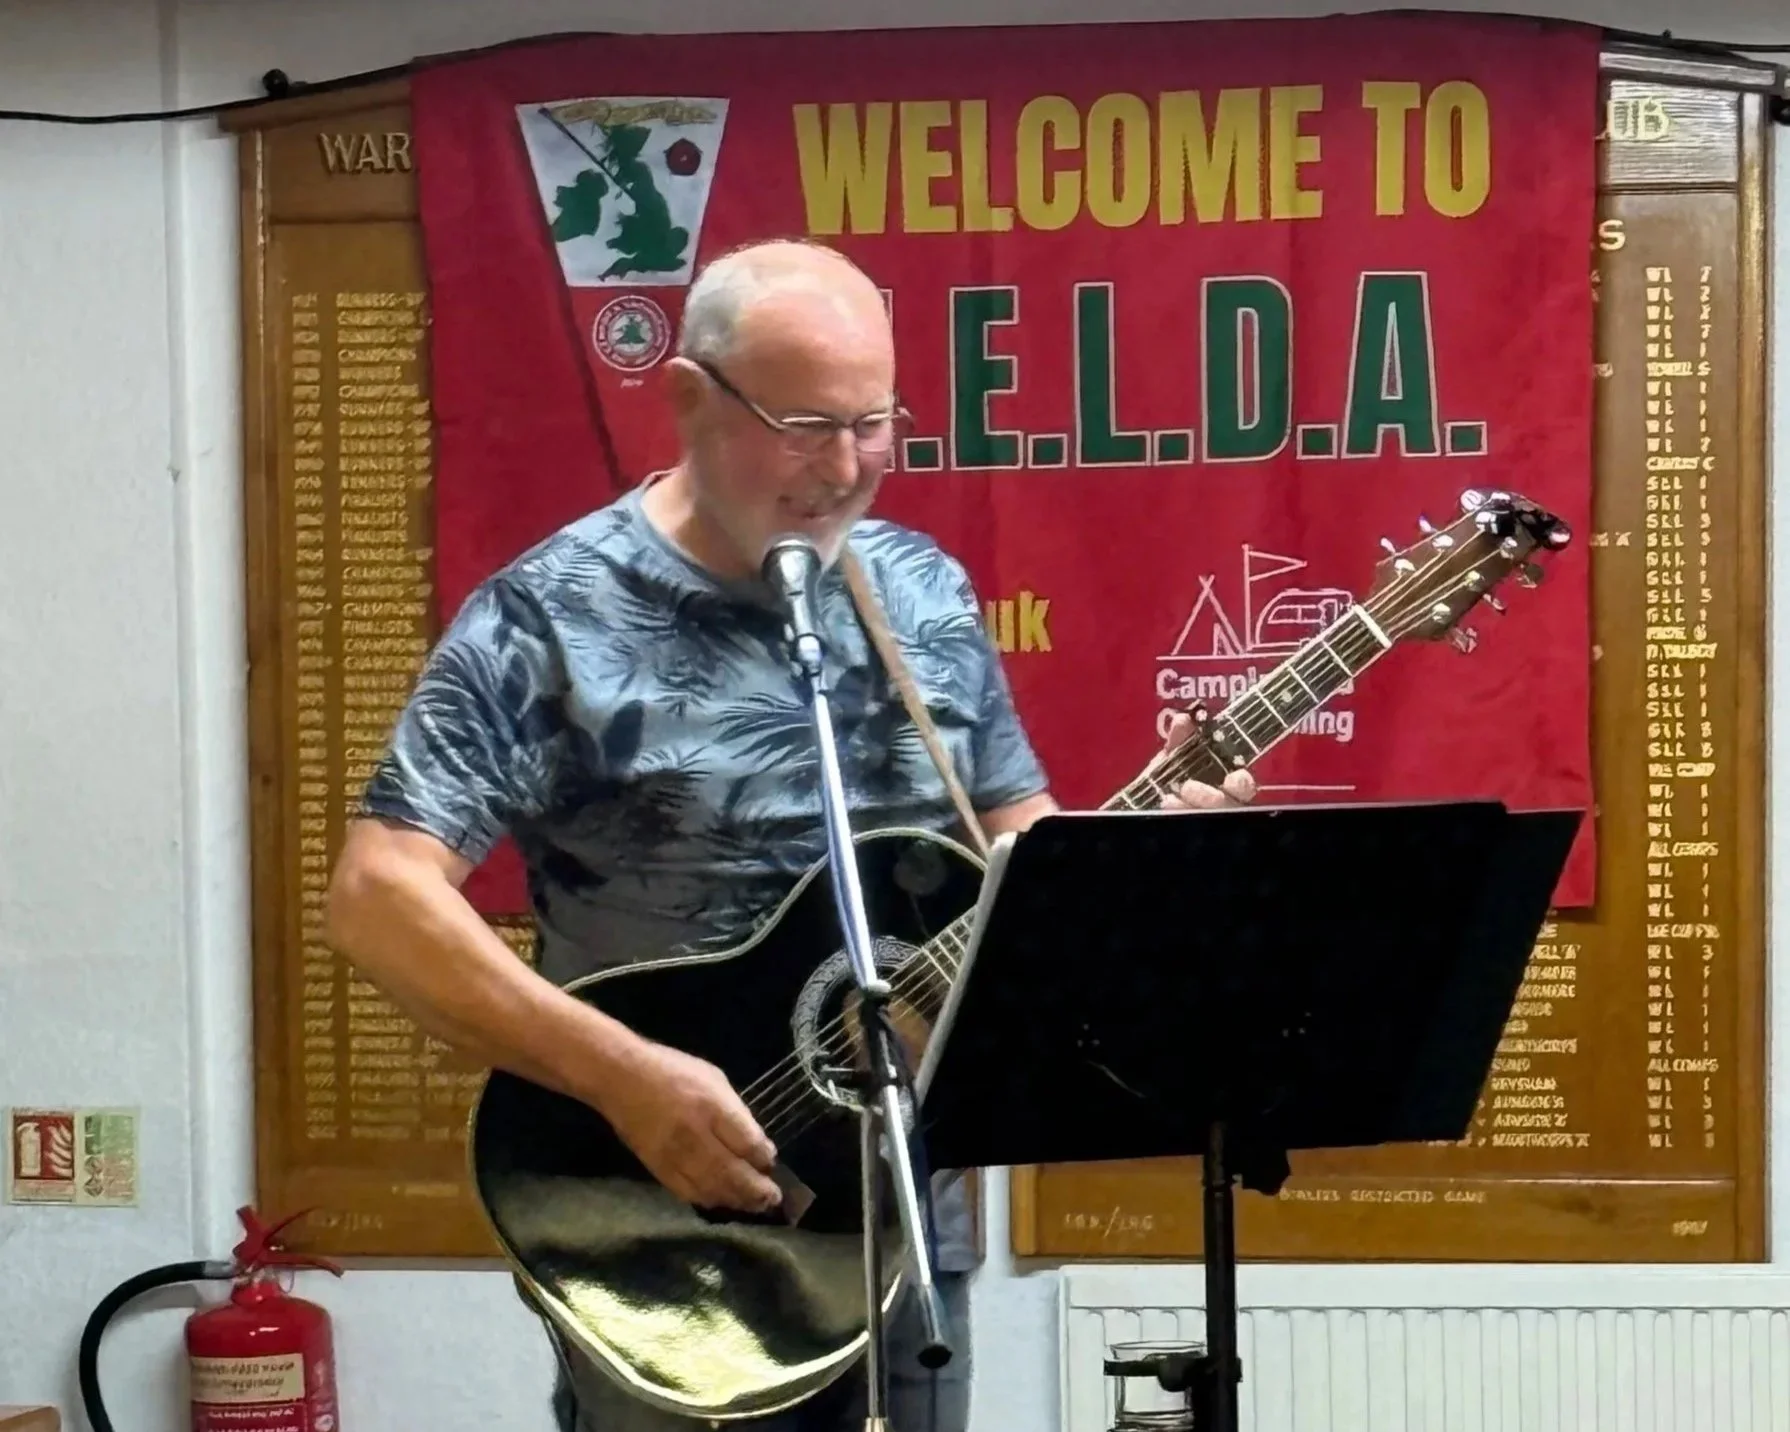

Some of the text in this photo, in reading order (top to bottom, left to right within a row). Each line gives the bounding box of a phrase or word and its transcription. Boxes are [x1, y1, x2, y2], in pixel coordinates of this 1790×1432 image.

[319, 132, 412, 173] WAR
[793, 81, 1491, 235] WELCOME TO
[879, 271, 1488, 473] .E.L.D.A.
